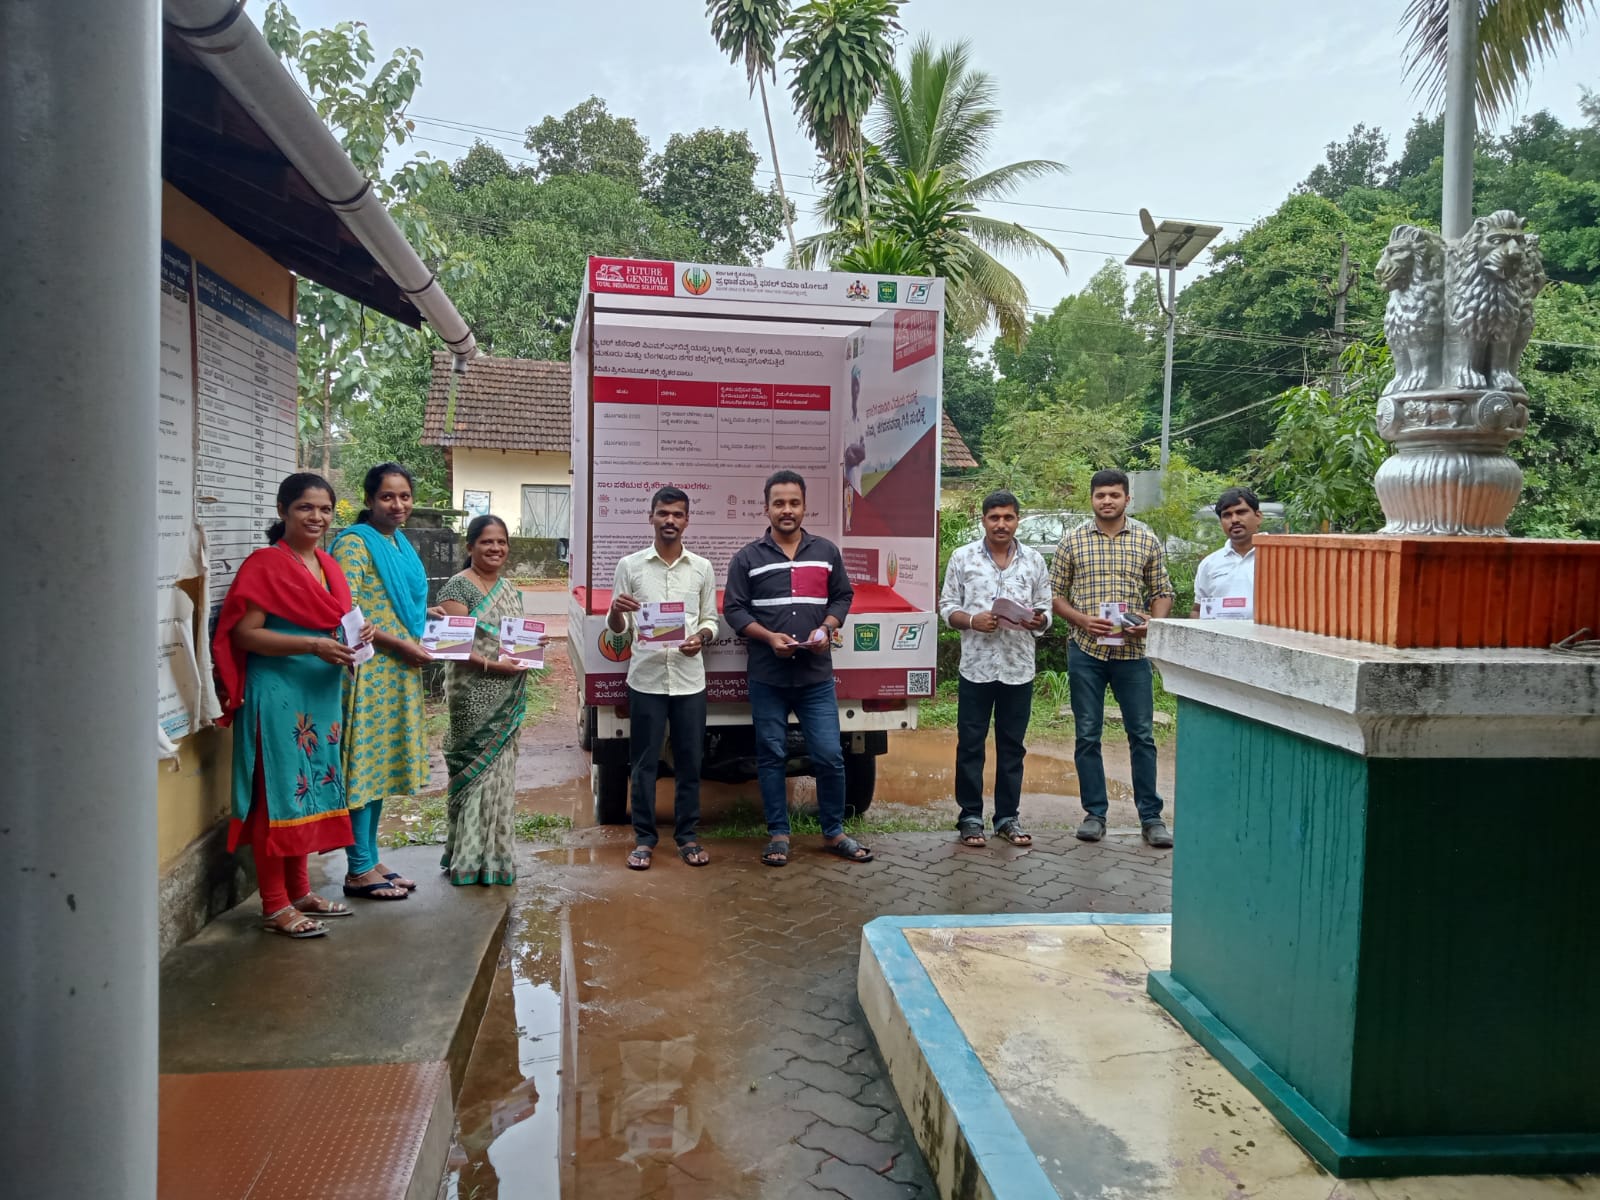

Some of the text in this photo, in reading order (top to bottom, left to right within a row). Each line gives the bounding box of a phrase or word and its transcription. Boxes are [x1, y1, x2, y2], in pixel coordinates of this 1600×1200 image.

[626, 265, 663, 276] FUTURE
[626, 274, 668, 285] GENERALI
[641, 283, 669, 291] SOLUTIONS
[911, 285, 928, 297] 75
[898, 626, 918, 641] 75
